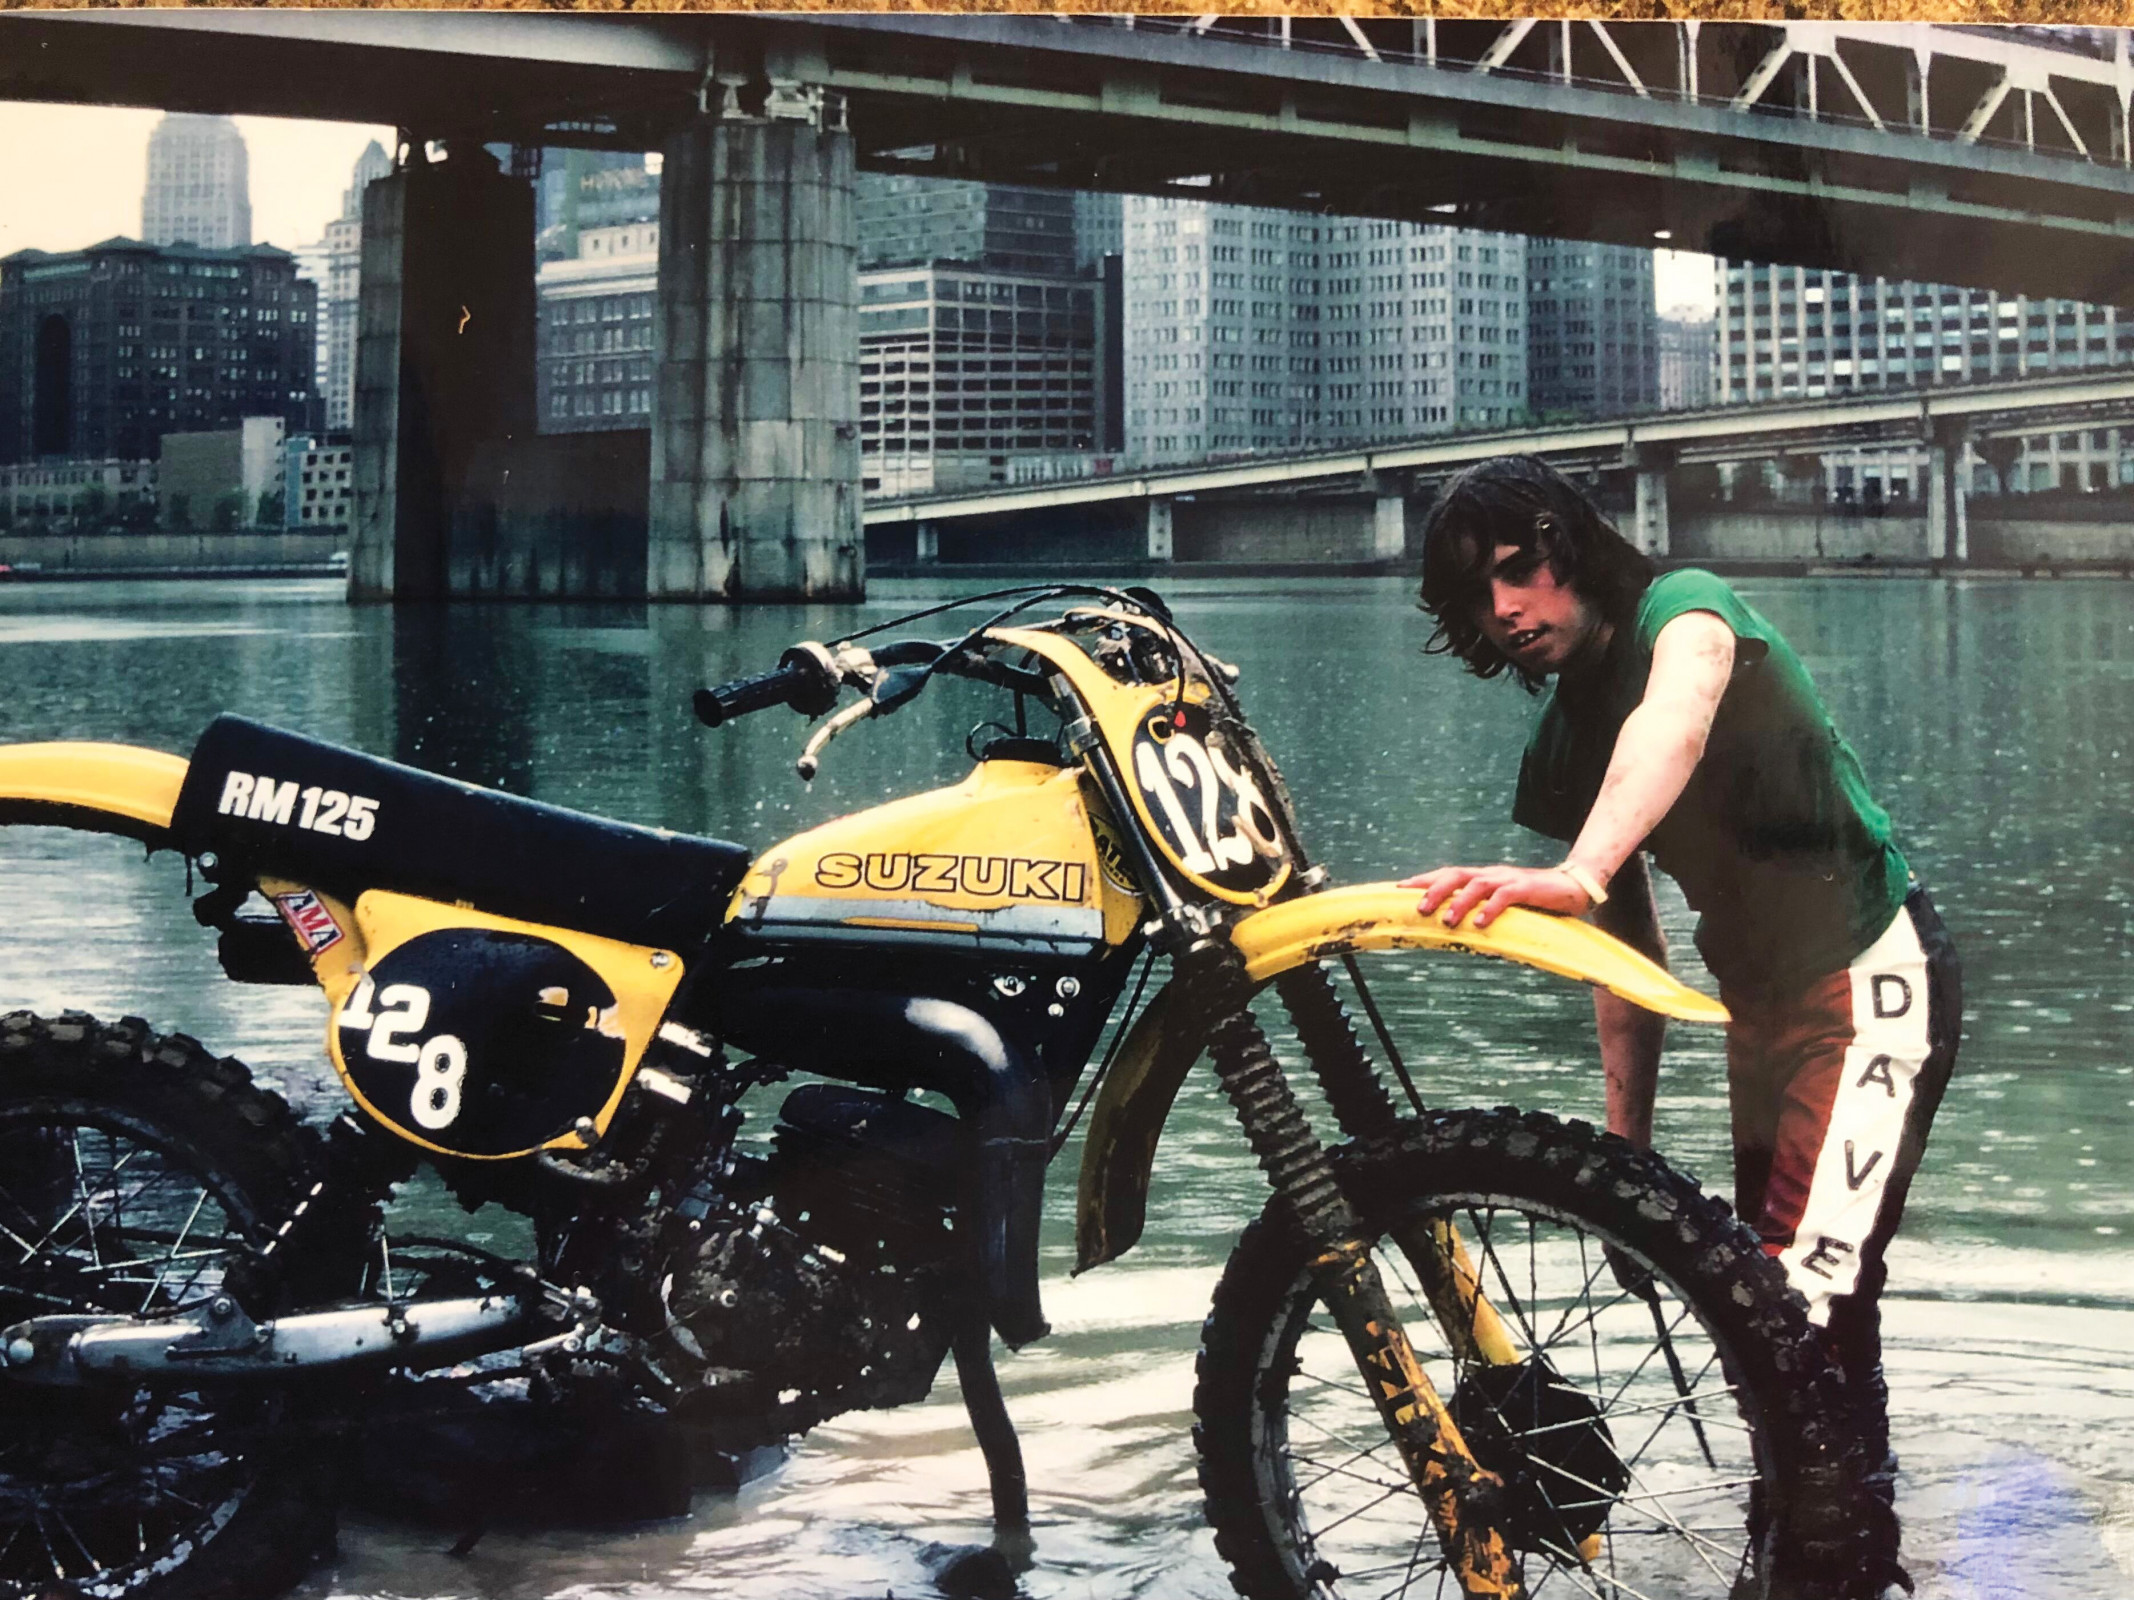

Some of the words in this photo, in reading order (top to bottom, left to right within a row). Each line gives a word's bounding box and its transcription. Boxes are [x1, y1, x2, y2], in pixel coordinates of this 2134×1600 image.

[281, 893, 341, 948] AMA
[815, 852, 1085, 901] SUZUKI
[339, 973, 468, 1129] 128
[1801, 974, 1912, 1280] DAVE
